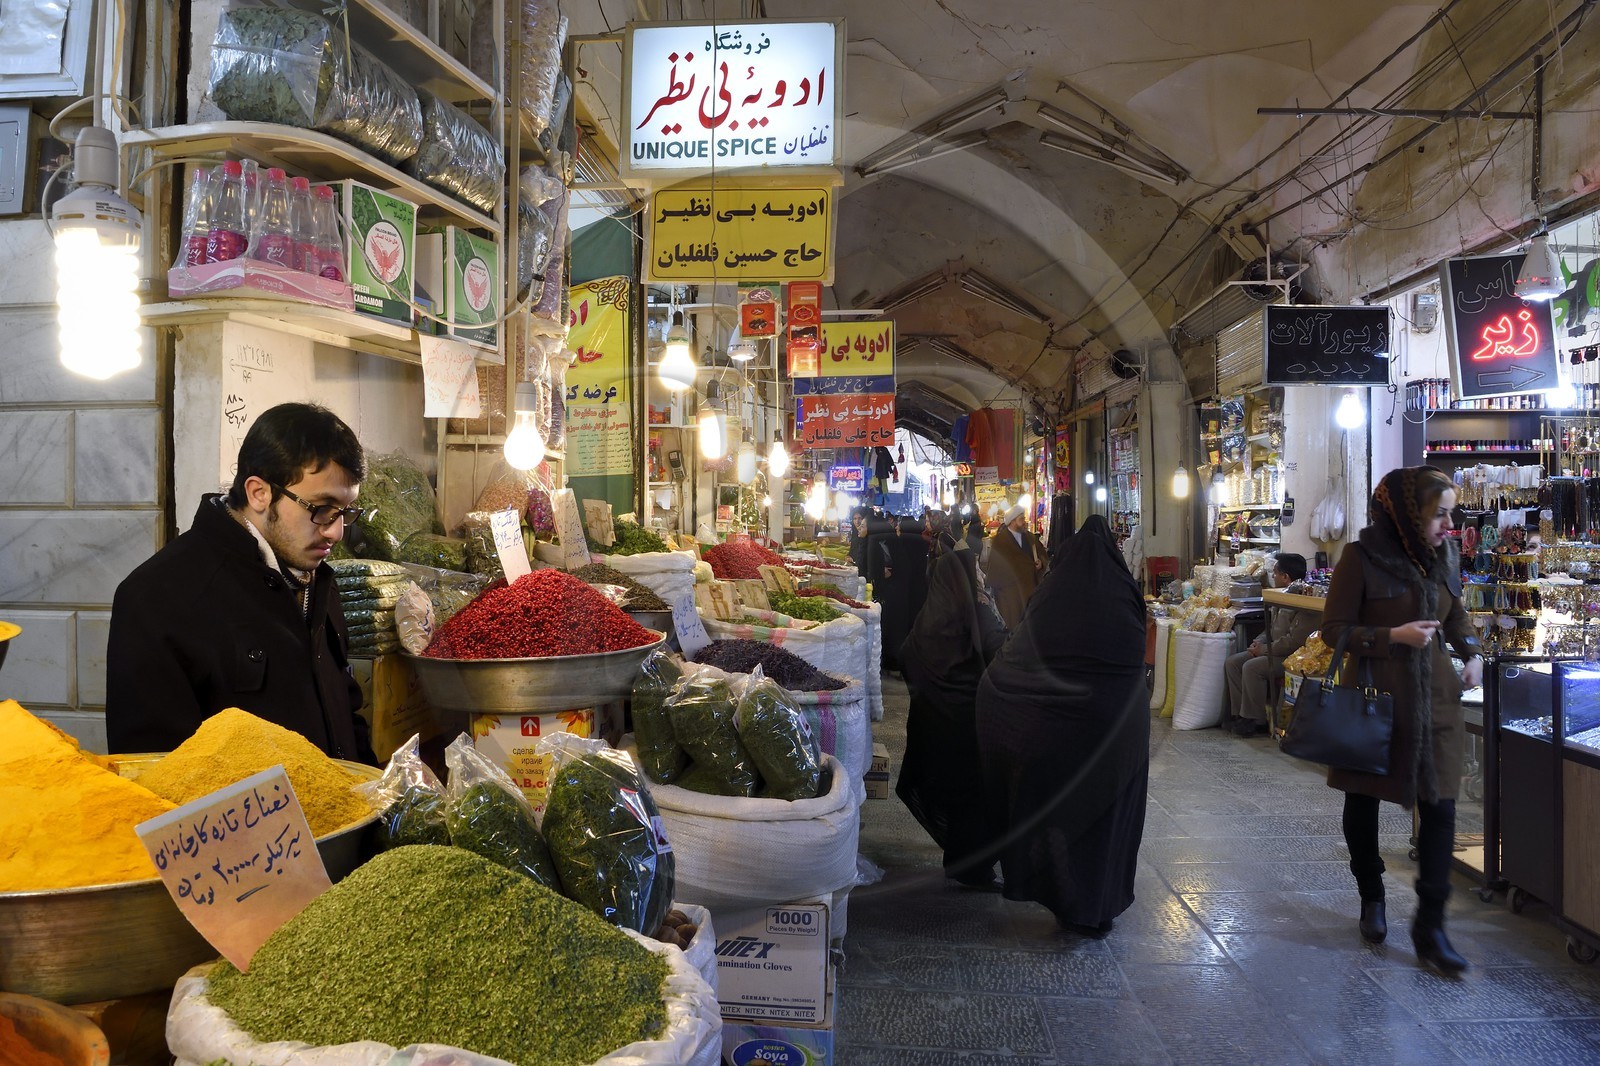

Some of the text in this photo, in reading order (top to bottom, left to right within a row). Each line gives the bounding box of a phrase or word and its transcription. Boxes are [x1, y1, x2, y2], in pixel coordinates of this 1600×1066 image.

[705, 30, 770, 54] فروشگاه
[636, 52, 696, 136] نظیر
[698, 61, 739, 132] بی
[634, 138, 776, 160] UNIQUE SPICE
[657, 197, 824, 223] ادویه بی نظیر
[658, 242, 822, 268] حاج حسین فلفلیان
[353, 283, 370, 294] GREEN
[354, 294, 384, 308] CARDAMOM
[854, 327, 890, 361] ادویه
[1475, 310, 1538, 360] زیر
[831, 336, 850, 362] بی
[584, 384, 617, 404] عرضه
[838, 378, 852, 392] علی
[853, 377, 874, 392] حاج
[804, 400, 893, 423] ادویه بی نظیر
[806, 426, 893, 444] حاج علی فلفلیان
[772, 912, 812, 926] 1000
[718, 960, 792, 972] amination Gloves
[754, 1048, 788, 1062] Soya
